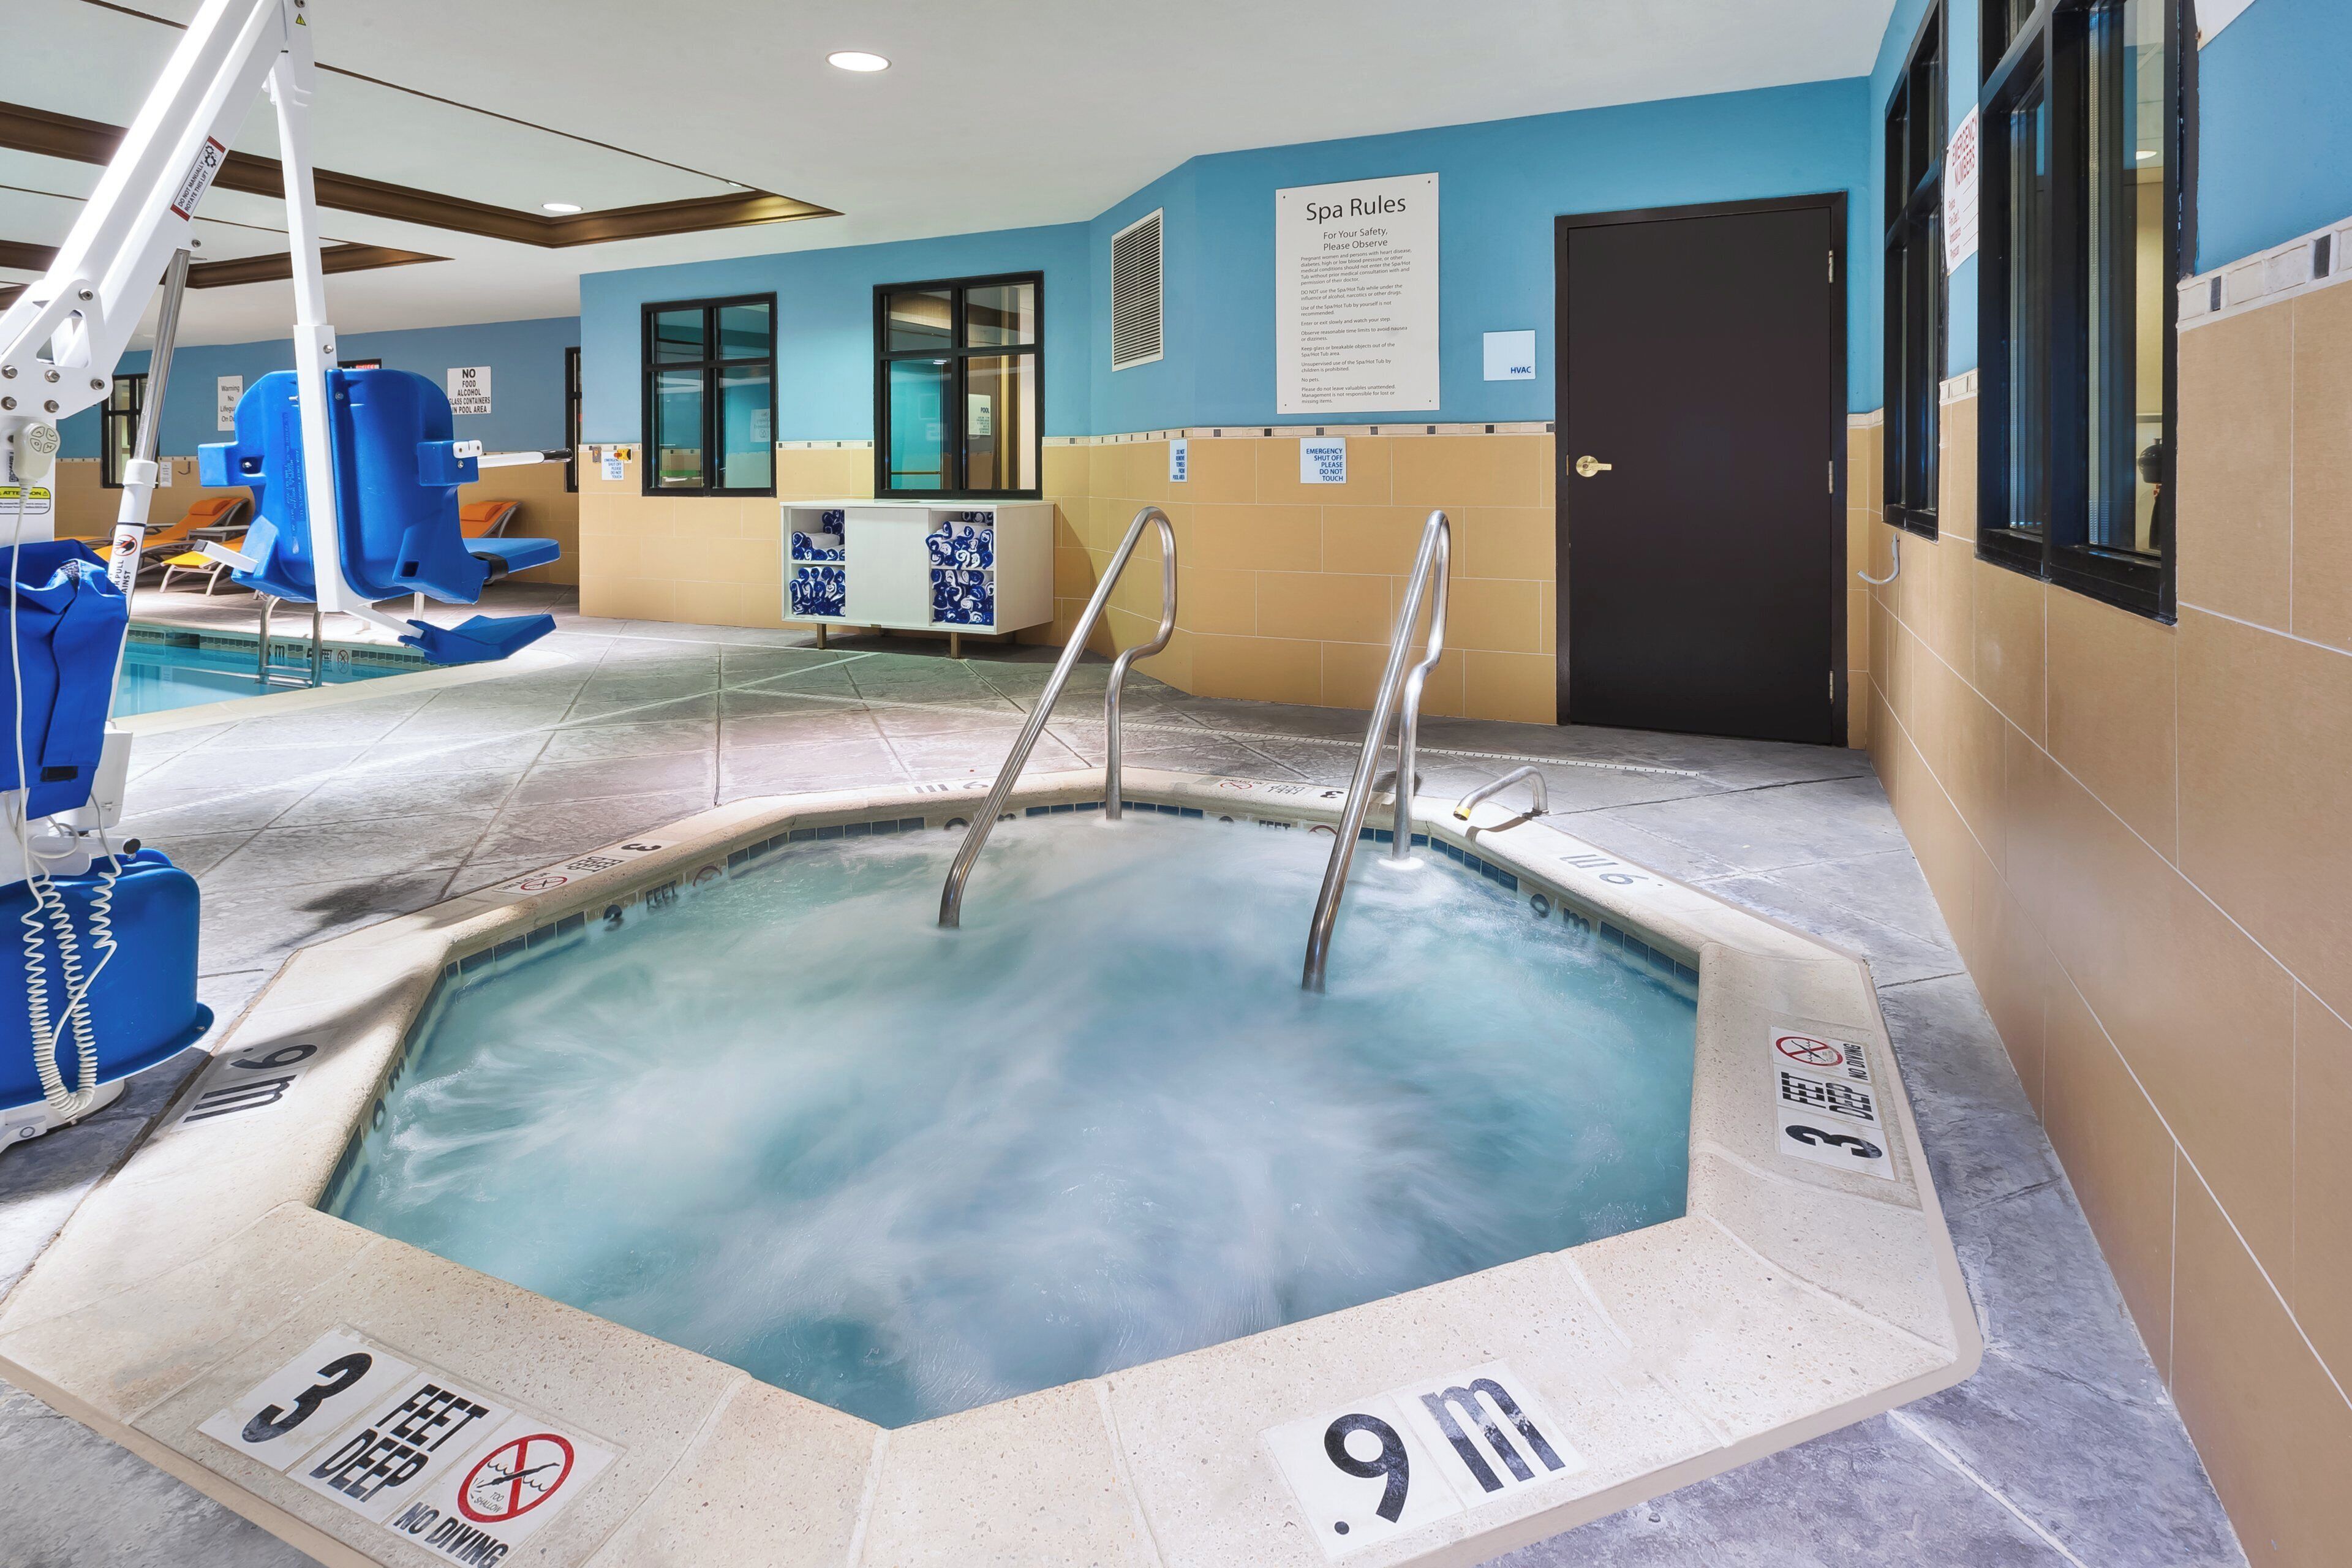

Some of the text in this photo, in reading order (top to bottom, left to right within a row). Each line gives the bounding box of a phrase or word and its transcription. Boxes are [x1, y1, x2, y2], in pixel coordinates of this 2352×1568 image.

[178, 198, 186, 207] DO
[189, 160, 205, 189] MANUALLY
[1954, 145, 1975, 189] NUMBERS
[184, 192, 197, 212] ROTATE
[1306, 194, 1406, 224] Spa Rules
[1352, 239, 1387, 248] Observe
[1360, 227, 1387, 236] Safety,
[462, 369, 476, 379] NO
[115, 560, 124, 579] PULL
[121, 571, 131, 594] AINST
[620, 843, 662, 852] 3
[580, 859, 625, 872] FEET
[1843, 1043, 1868, 1080] NO DIVING
[183, 1074, 298, 1123] m
[1781, 1072, 1826, 1109] FEET
[1825, 1083, 1874, 1121] DEEP
[1785, 1125, 1883, 1159] 3
[241, 1352, 373, 1444] 3
[376, 1383, 490, 1452] FEET
[309, 1428, 429, 1502] DEEP
[1324, 1378, 1566, 1536] .9 m
[474, 1497, 503, 1513] SHALLOW
[490, 1492, 504, 1502] TOO
[393, 1501, 510, 1568] NO DIVING
